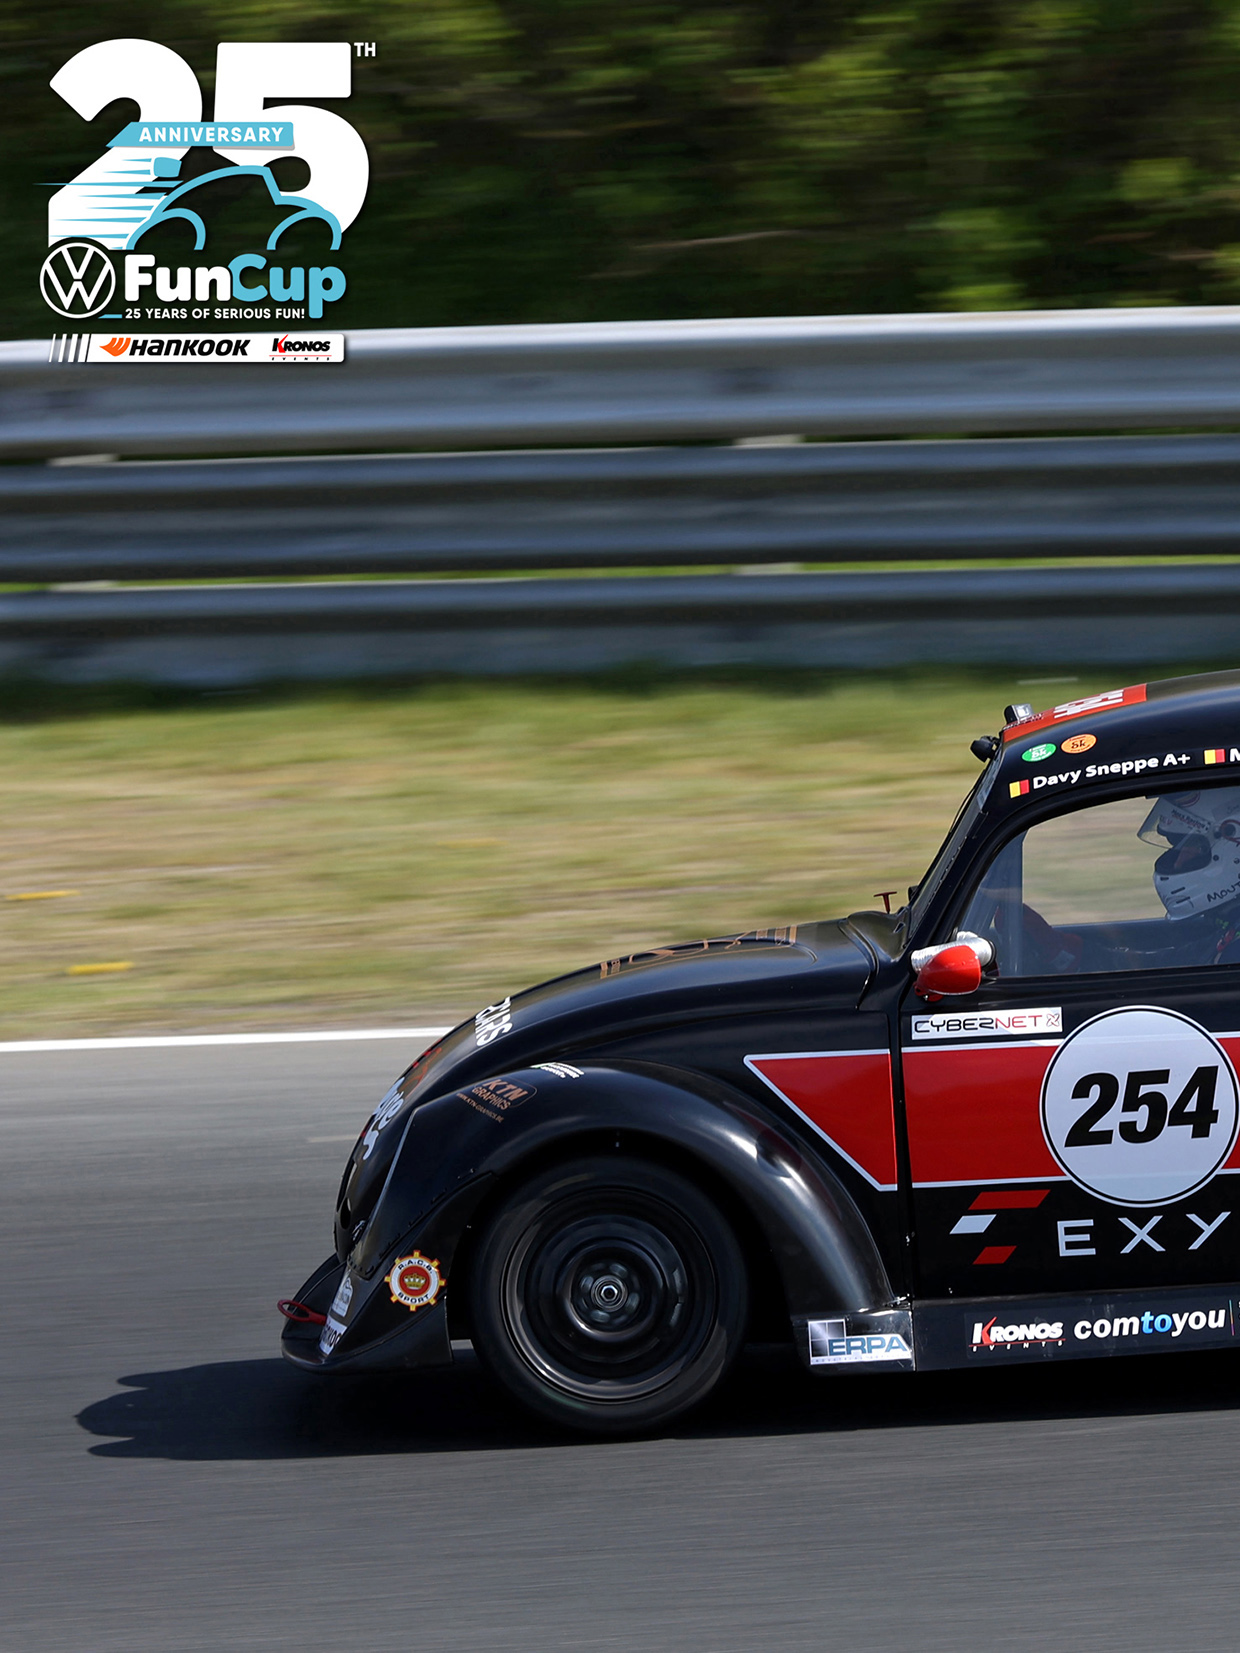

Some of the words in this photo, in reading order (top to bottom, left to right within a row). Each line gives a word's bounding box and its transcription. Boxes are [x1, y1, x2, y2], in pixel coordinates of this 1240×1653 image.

[1033, 769, 1081, 790] Davy
[1086, 757, 1159, 777] Sneppe
[1163, 753, 1191, 767] A+
[471, 1086, 511, 1110] GRAPHICS
[482, 1079, 528, 1101] KTN
[1064, 1065, 1219, 1148] 254
[398, 1292, 429, 1304] SPORT
[972, 1316, 1064, 1345] KRONOS
[1074, 1309, 1226, 1339] comtoyou
[828, 1336, 908, 1356] ERPA
